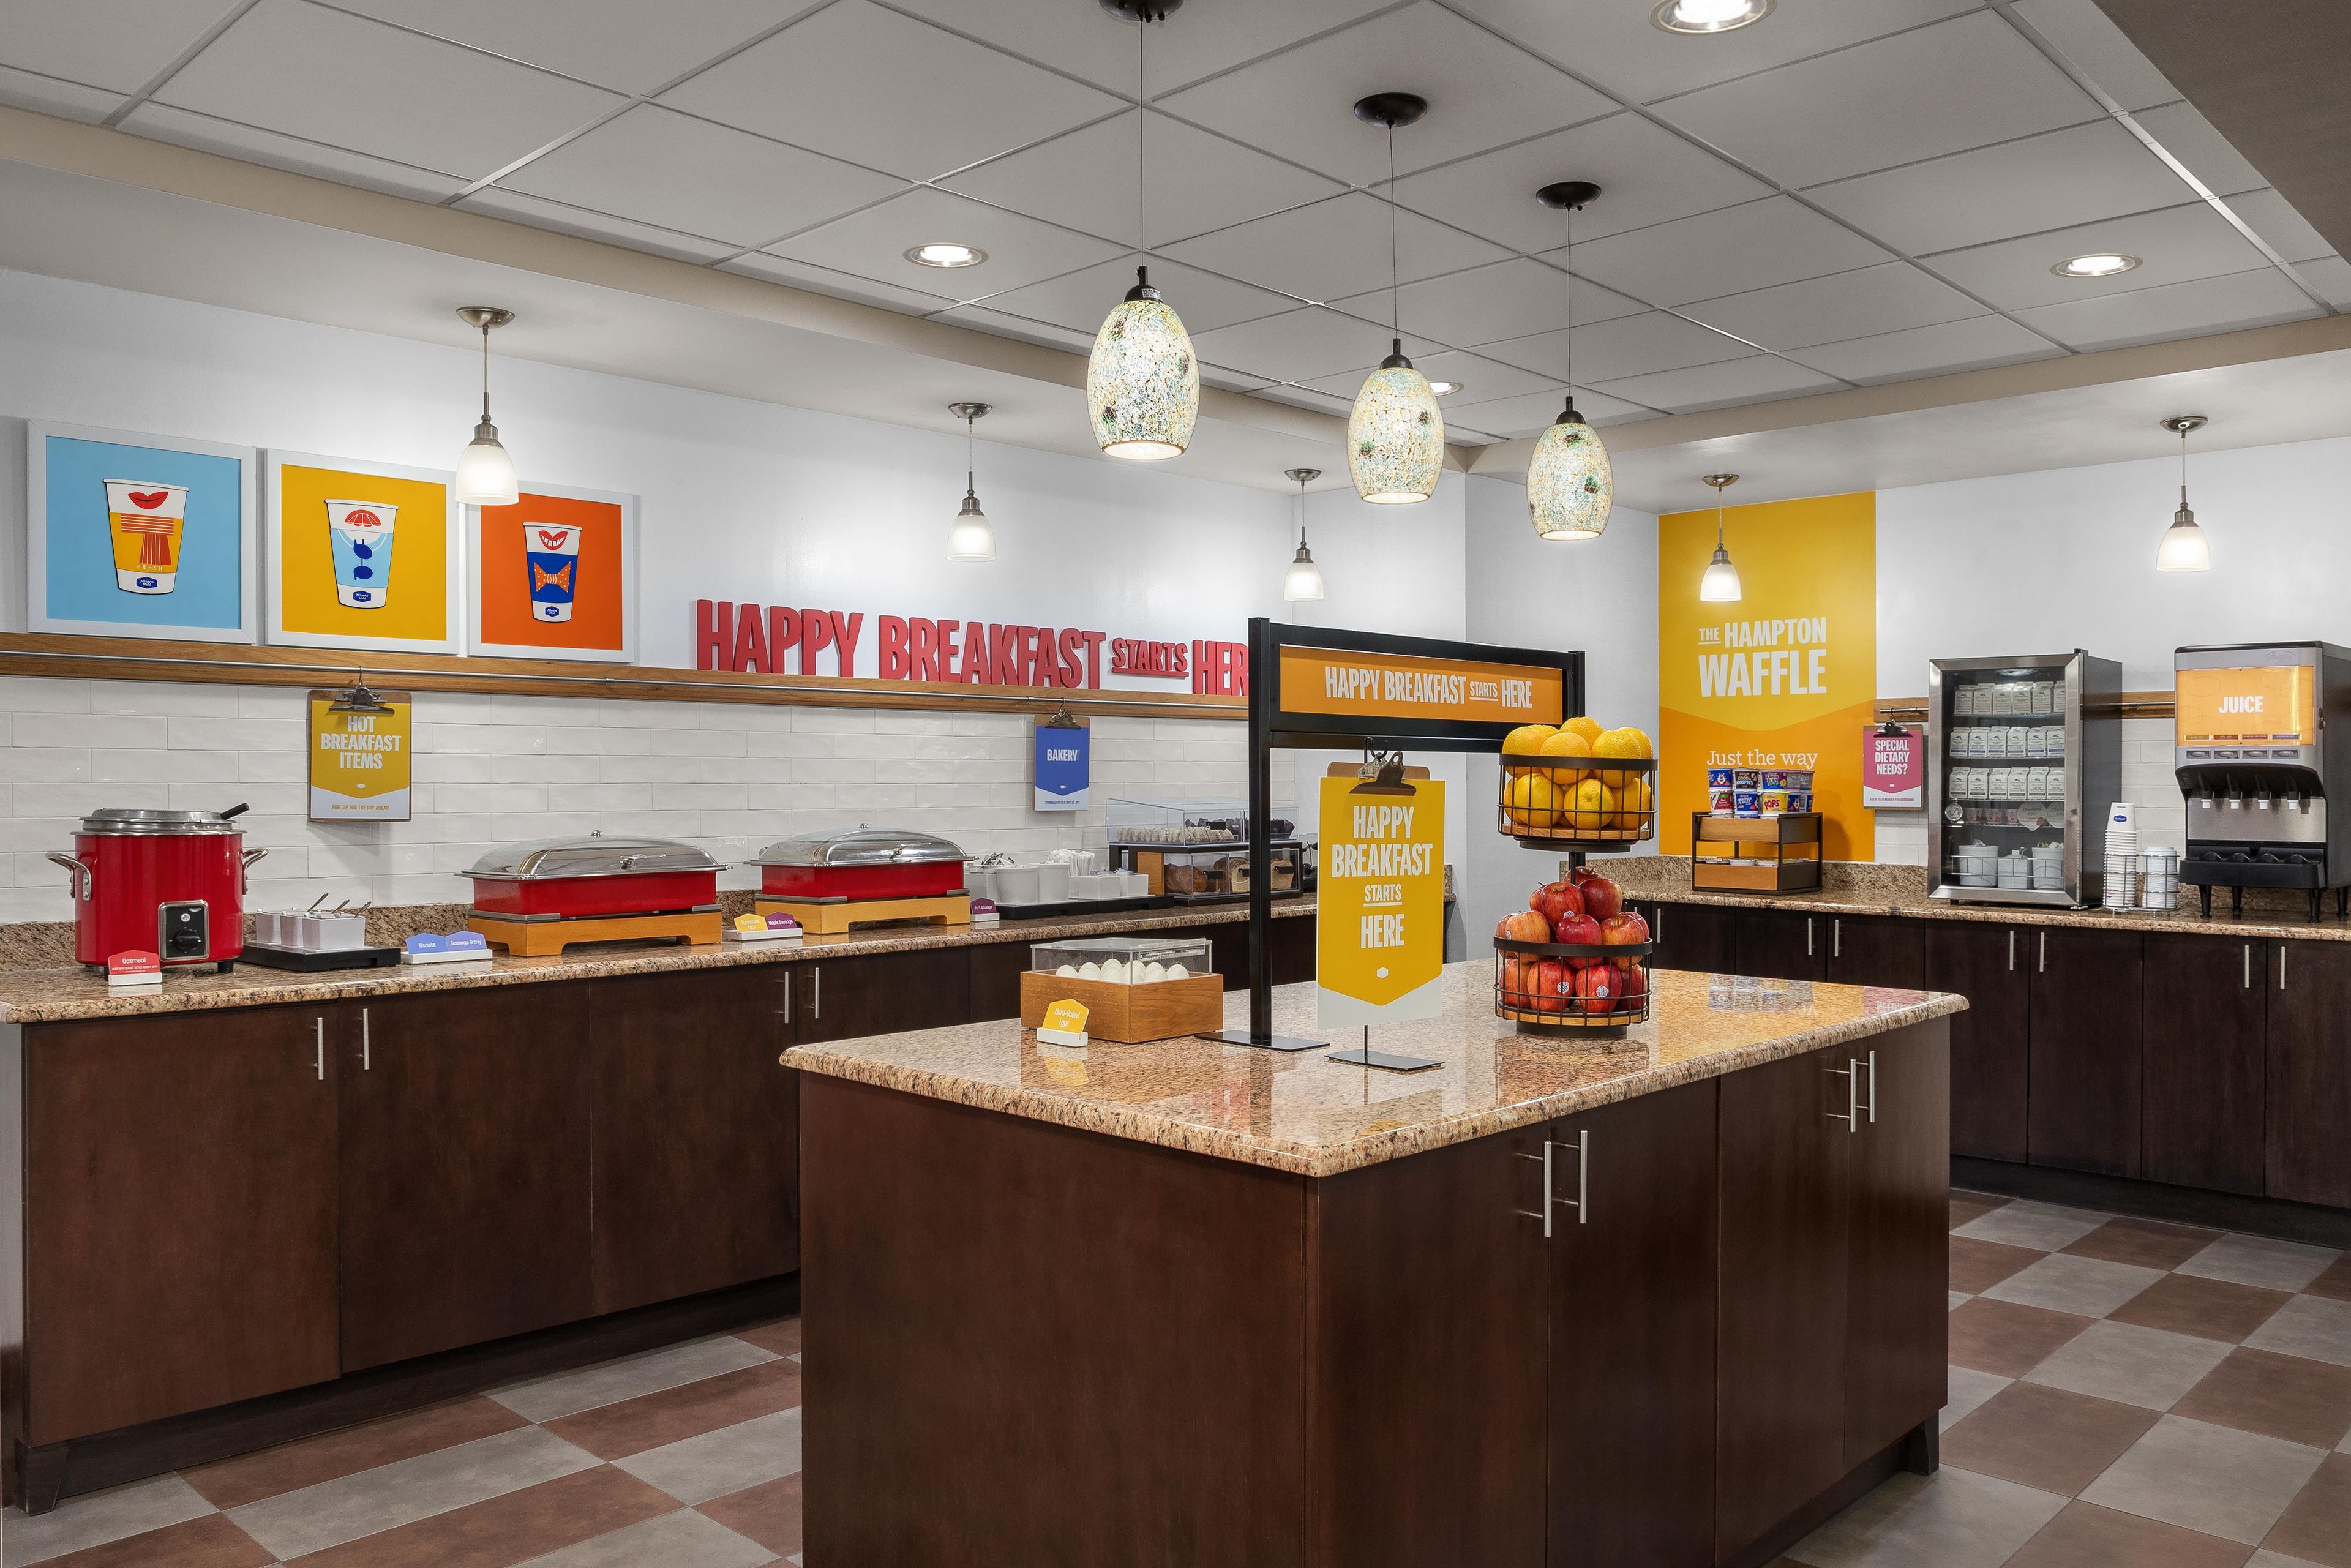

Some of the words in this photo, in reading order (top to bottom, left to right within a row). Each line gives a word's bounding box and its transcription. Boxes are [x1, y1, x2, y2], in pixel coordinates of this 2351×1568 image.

[1698, 627, 1720, 642] THE
[1724, 617, 1826, 648] HAMPTON
[697, 599, 864, 677] HAPPY
[879, 614, 1106, 690] BREAKFAST
[1112, 637, 1188, 672] STARTS
[1192, 639, 1248, 696] HER
[1698, 648, 1827, 698] WAFFLE
[1325, 666, 1380, 700] HAPPY
[1384, 670, 1466, 705] BREAKFAST
[1469, 681, 1498, 697] STARTS
[1501, 679, 1532, 708] HERE
[2218, 696, 2263, 713] JUICE
[347, 715, 376, 732] HOT
[321, 733, 402, 751] BREAKFAST
[1875, 740, 1909, 751] SPECIAL
[340, 752, 383, 769] ITEMS
[1047, 749, 1078, 762] BAKERY
[1706, 750, 1743, 765] Just
[1747, 749, 1776, 765] the
[1780, 753, 1819, 770] way
[1875, 752, 1910, 763] DIETARY
[1877, 763, 1908, 775] NEEDS?
[1353, 806, 1414, 839] HAPPY
[1332, 843, 1433, 878] BREAKFAST
[1364, 883, 1402, 902] STARTS
[1360, 913, 1405, 949] HERE
[1054, 1008, 1081, 1019] Hard-Boiled
[1059, 1018, 1070, 1028] Eggs
